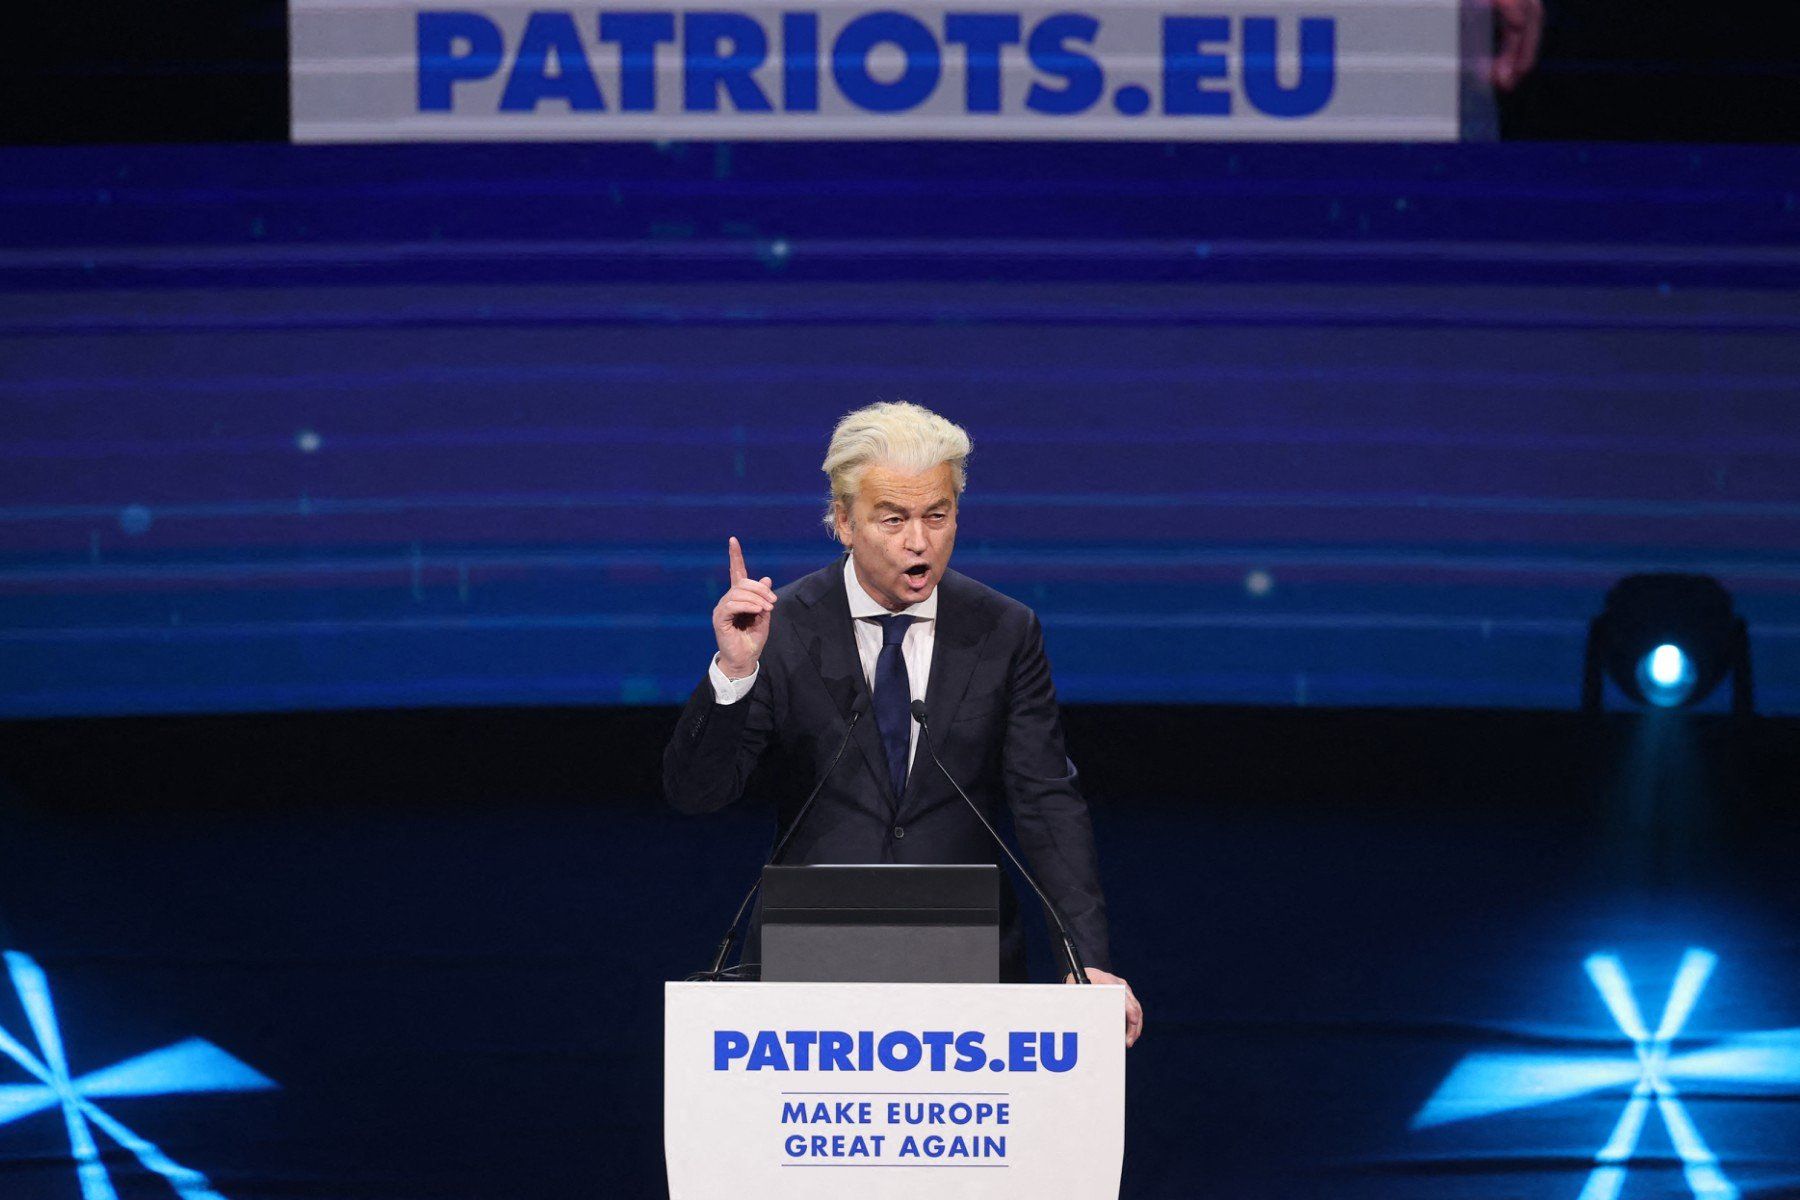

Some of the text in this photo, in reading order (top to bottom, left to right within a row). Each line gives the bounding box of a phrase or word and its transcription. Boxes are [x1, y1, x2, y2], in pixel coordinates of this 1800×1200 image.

[415, 9, 1338, 119] PATRIOTS.EU
[714, 1030, 1078, 1073] PATRIOTS.EU
[781, 1102, 1010, 1125] MAKE EUROPE
[784, 1135, 1007, 1158] GREAT AGAIN
